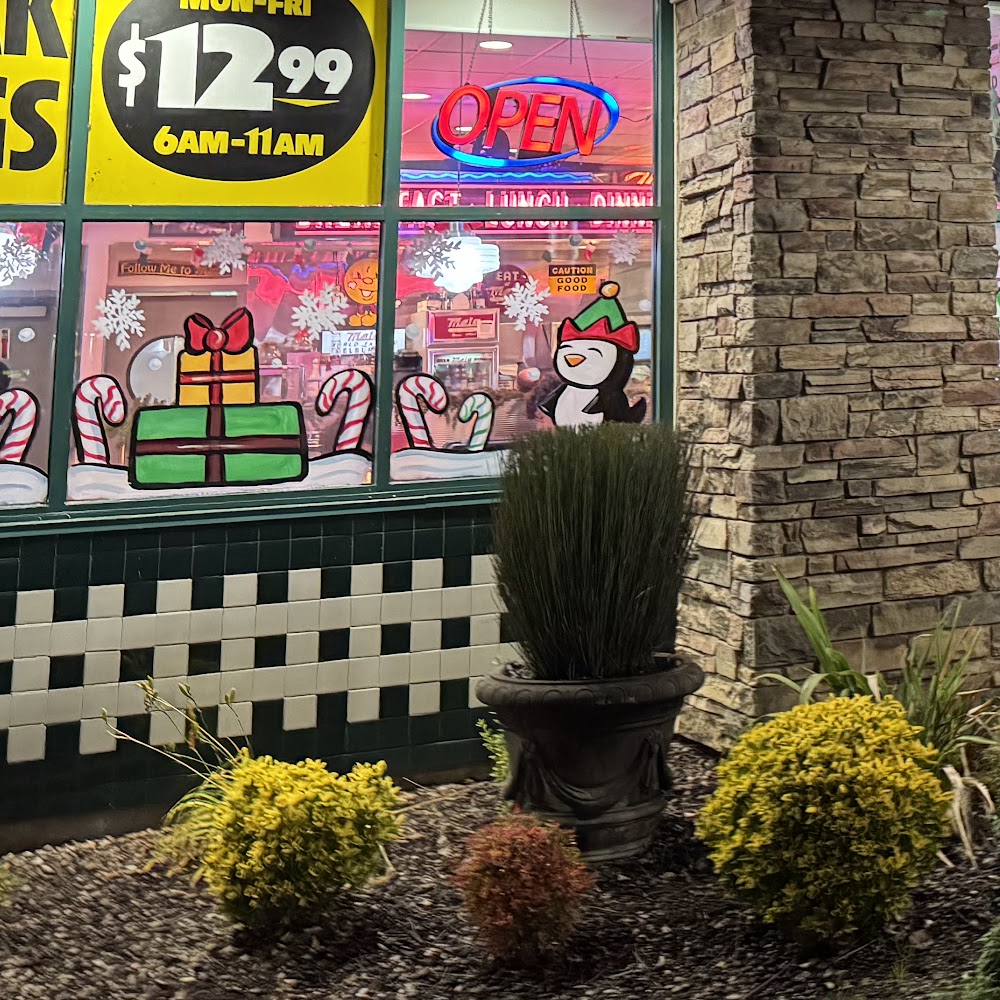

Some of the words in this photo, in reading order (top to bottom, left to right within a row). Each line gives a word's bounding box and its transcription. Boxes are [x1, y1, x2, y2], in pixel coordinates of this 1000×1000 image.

[437, 84, 602, 157] OPEN
[153, 125, 325, 158] 6AM-11AM
[120, 262, 156, 274] Follow
[160, 263, 178, 275] Me
[552, 266, 593, 275] CAUTION
[496, 271, 520, 281] EAT
